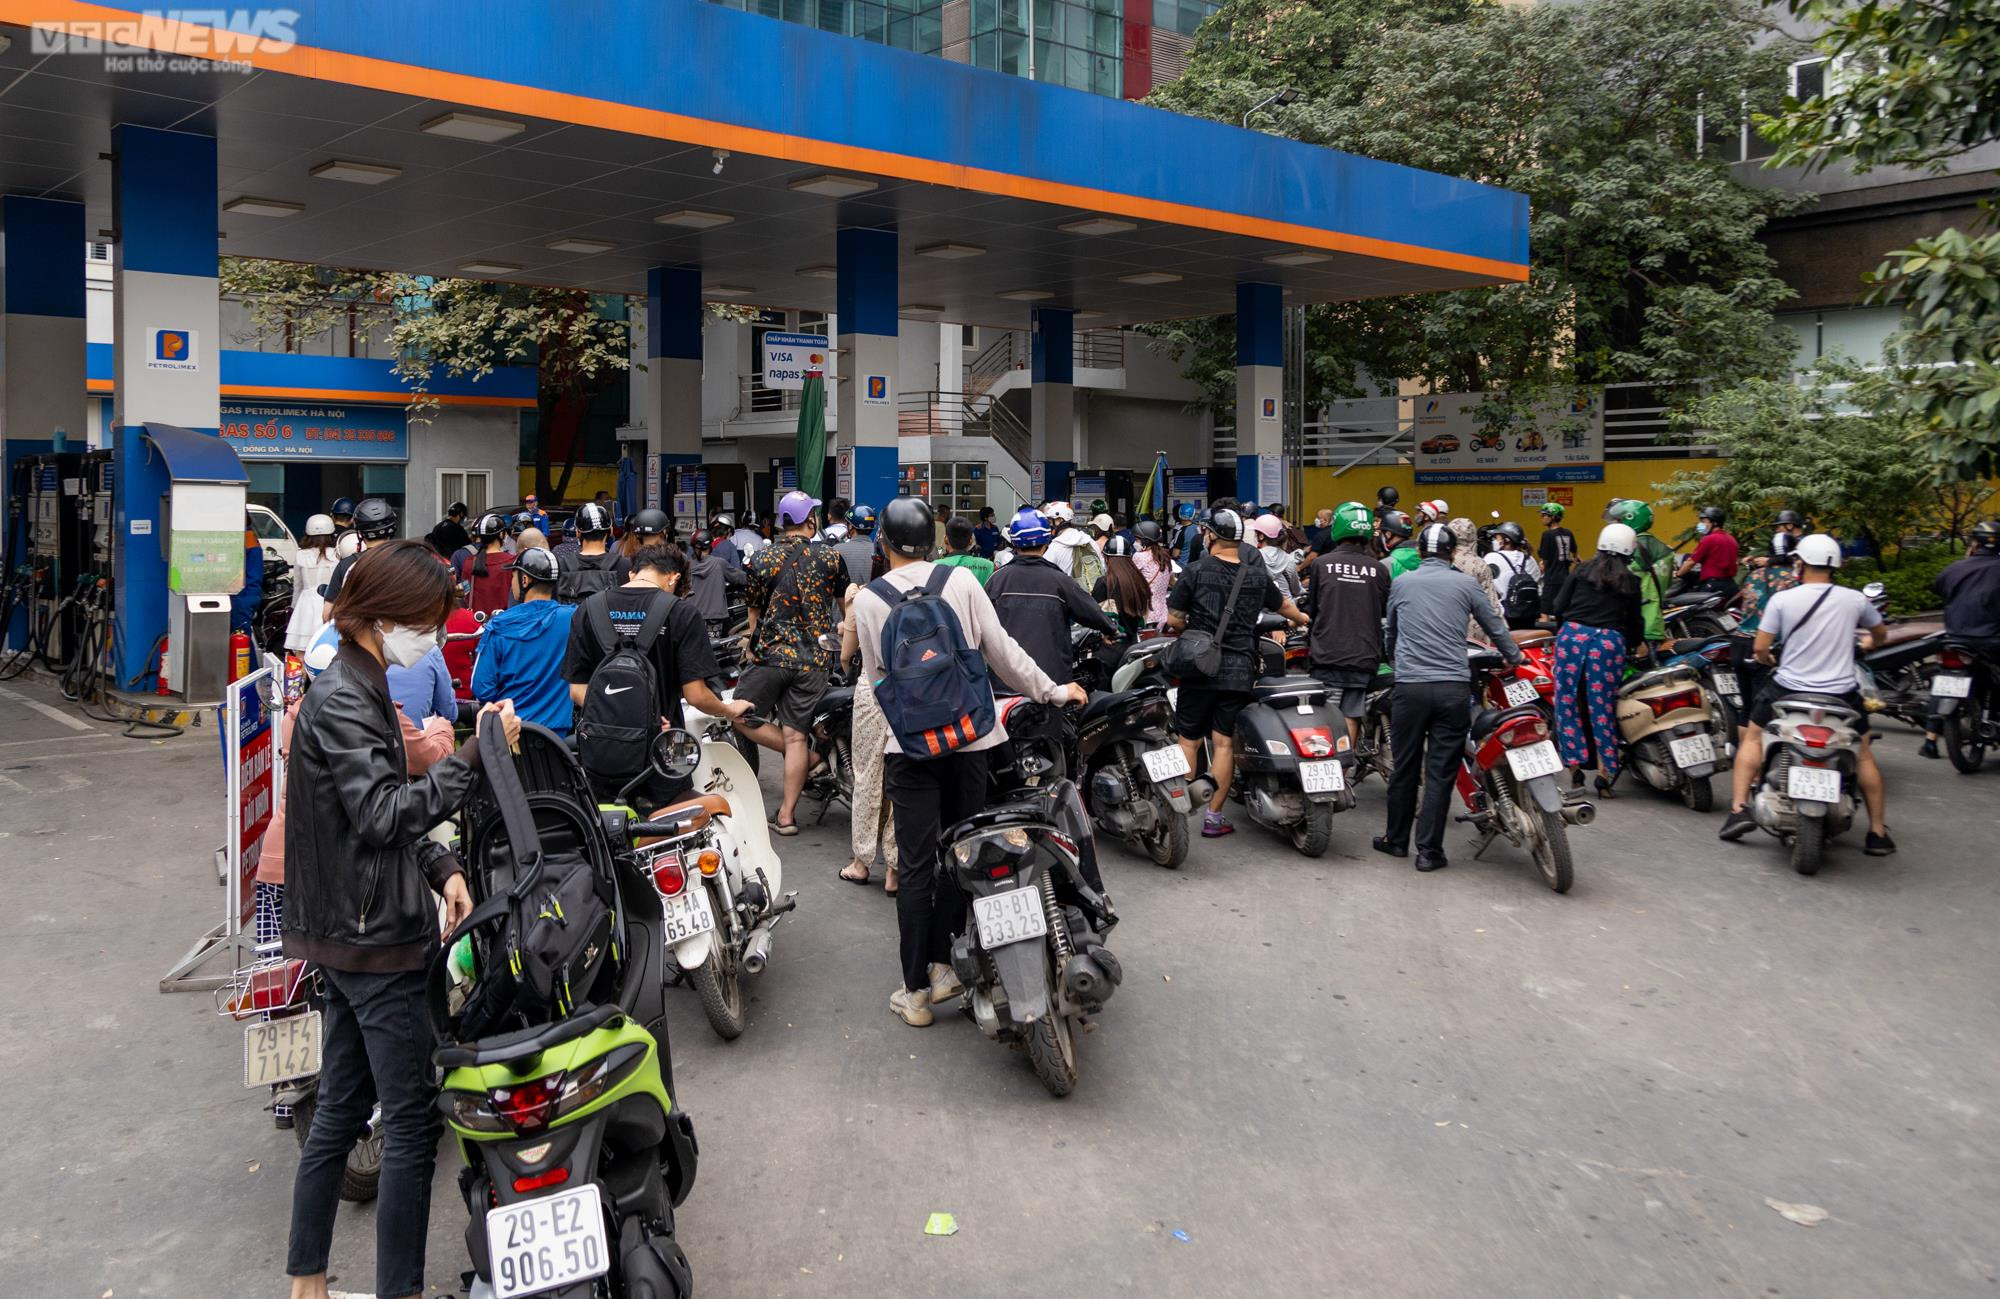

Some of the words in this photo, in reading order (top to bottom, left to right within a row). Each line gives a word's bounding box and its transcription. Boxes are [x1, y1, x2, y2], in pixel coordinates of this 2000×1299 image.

[148, 362, 196, 370] PETROLIMEX
[769, 352, 793, 362] VISA
[769, 369, 800, 381] napas
[245, 407, 308, 417] PETROLIMEX
[310, 409, 325, 418] HÀ
[254, 418, 279, 439] SỐ
[281, 425, 293, 439] 6
[1350, 521, 1371, 530] Grab
[1326, 563, 1377, 577] TEELAB
[1150, 748, 1178, 766] 29-E2
[1307, 763, 1336, 776] 29-D2
[1520, 758, 1554, 777] 3015
[1306, 777, 1341, 791] 072.73
[665, 892, 700, 919] 9-AA
[984, 892, 1030, 921] 29-B1
[666, 911, 710, 940] 65.48
[984, 913, 1040, 944] 333.25
[257, 1017, 311, 1053] 29-F4
[258, 1047, 310, 1080] 7142
[504, 1197, 584, 1248] 29-E2
[500, 1235, 599, 1291] 906.50
